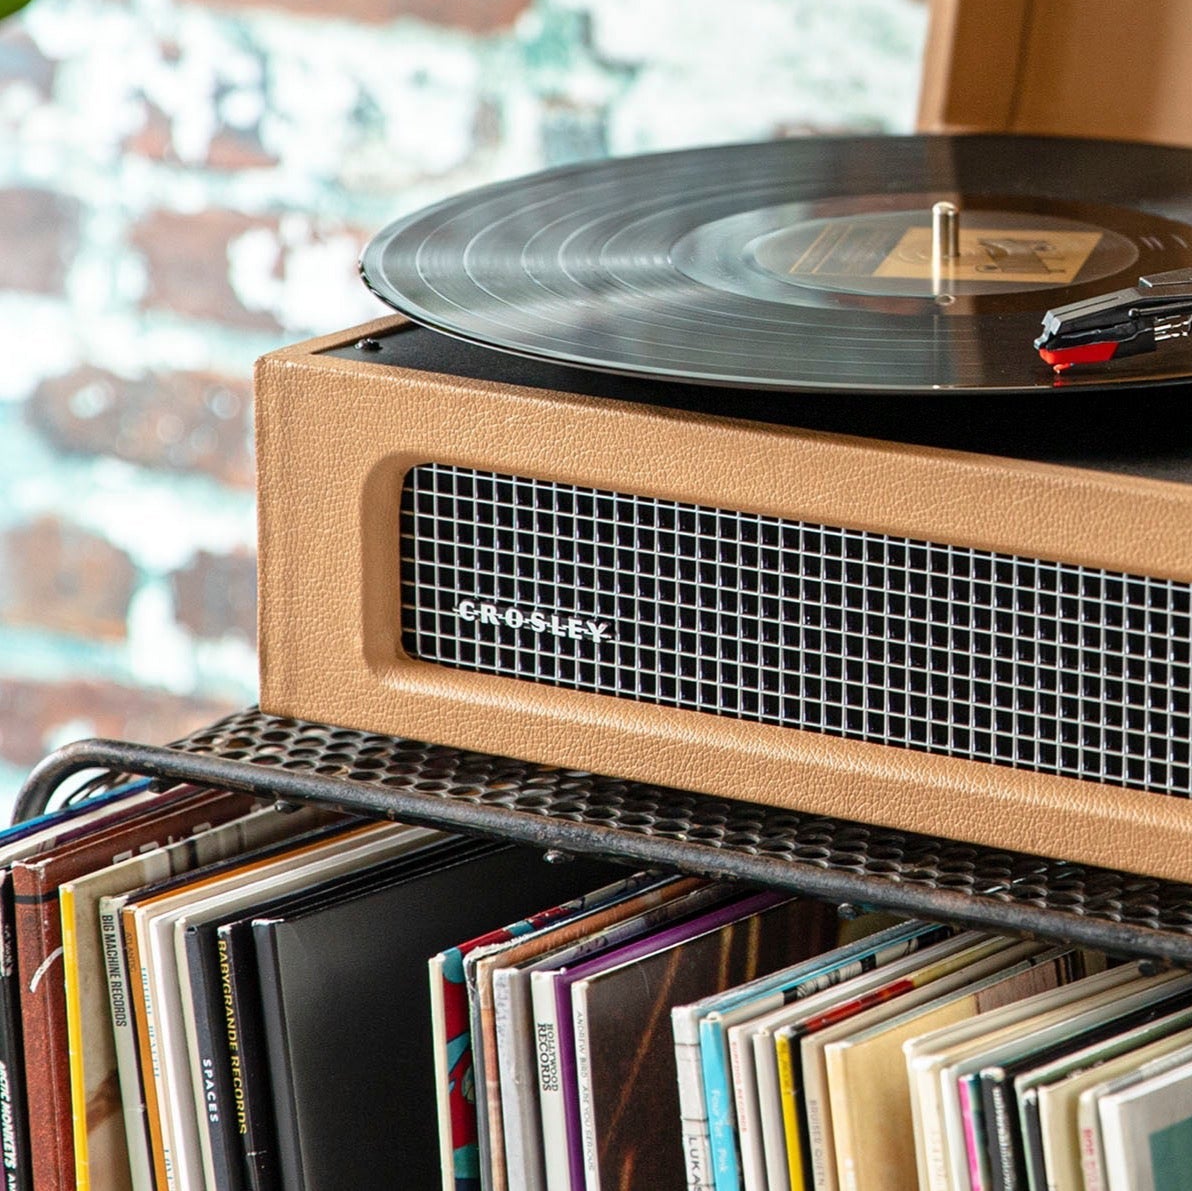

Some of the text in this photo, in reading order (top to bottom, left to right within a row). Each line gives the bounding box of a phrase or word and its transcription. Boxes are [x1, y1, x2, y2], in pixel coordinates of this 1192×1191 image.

[456, 600, 609, 643] CROSLEY
[102, 914, 127, 1027] BIG MACHINE RECORDS
[218, 940, 248, 1135] BABYGRANDE RECORDS
[537, 1023, 551, 1092] RECORDS
[545, 1023, 559, 1092] HOLLYWOOD
[577, 1011, 586, 1052] ANDREW
[202, 1059, 219, 1123] SPACES
[580, 1057, 589, 1078] BIRD
[582, 1085, 590, 1104] ARE
[1, 1101, 17, 1170] MONKEYS
[583, 1104, 591, 1126] YOU
[711, 1089, 729, 1173] Four Tet Pink
